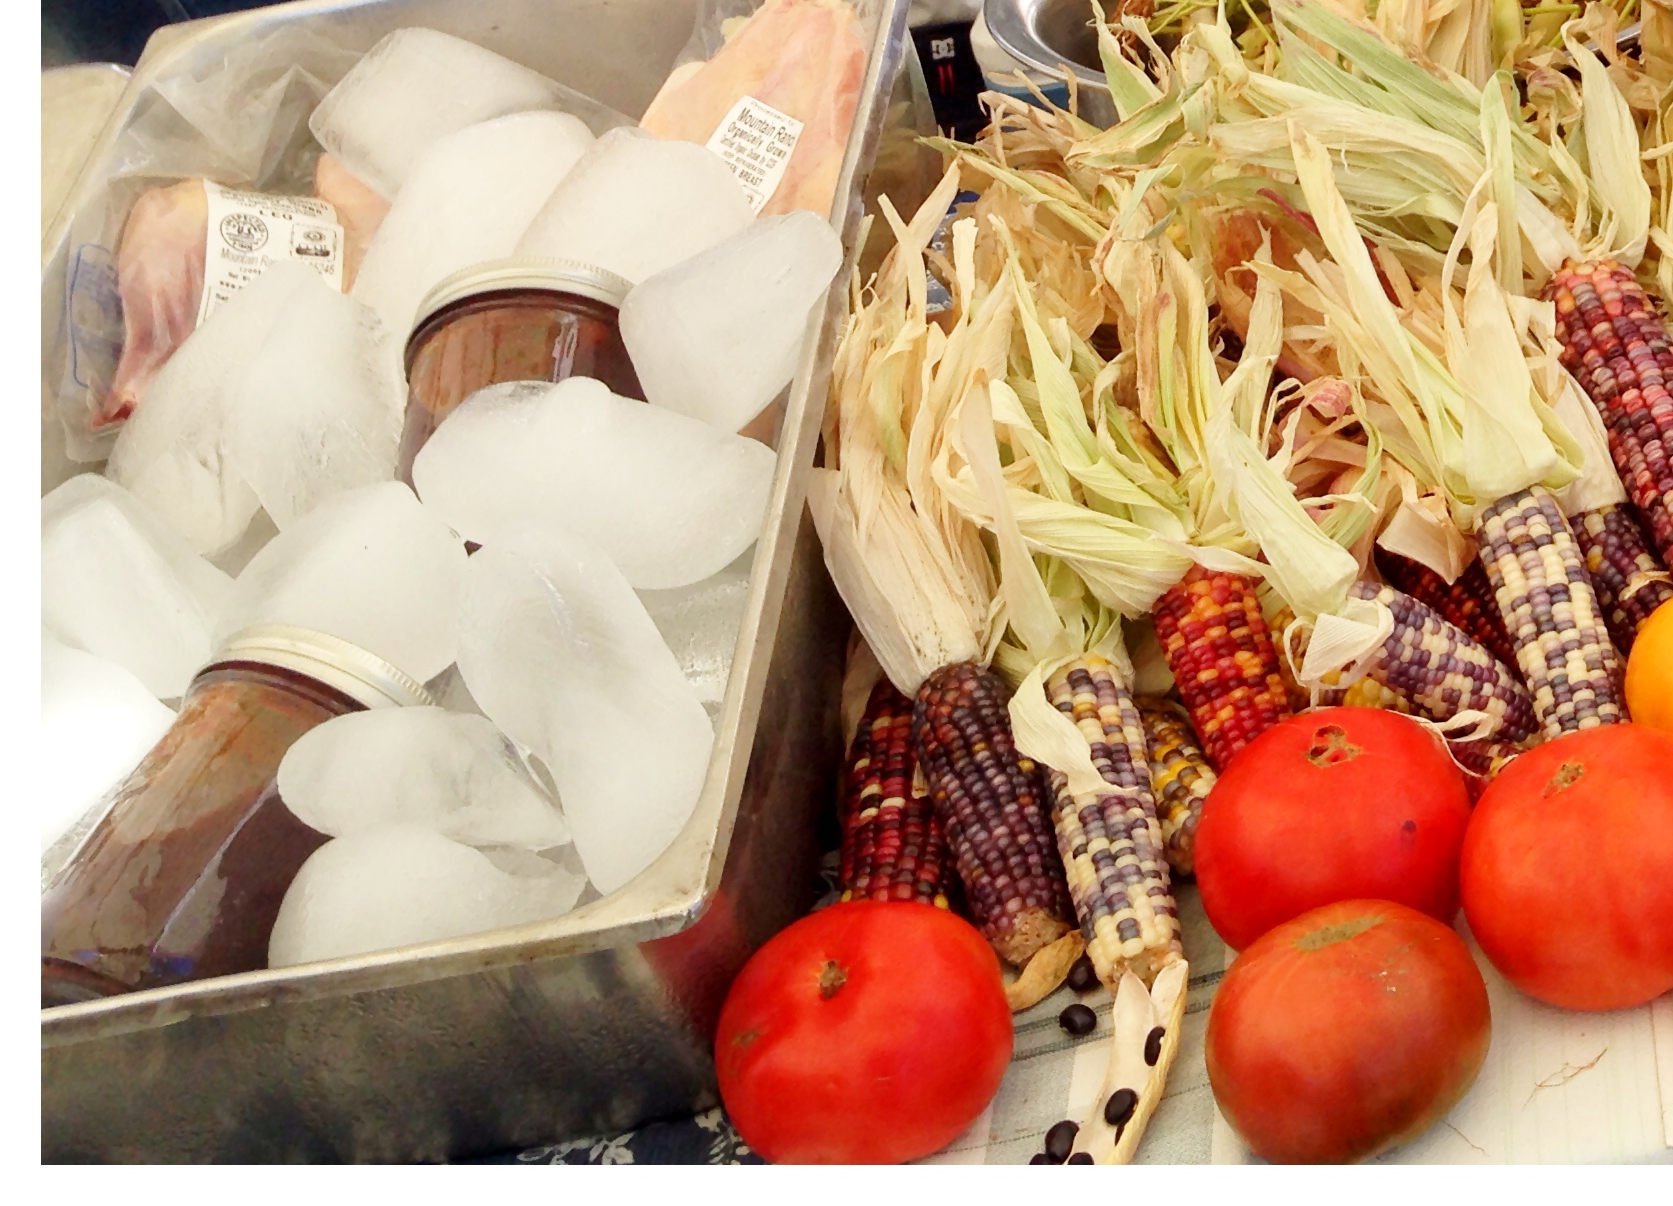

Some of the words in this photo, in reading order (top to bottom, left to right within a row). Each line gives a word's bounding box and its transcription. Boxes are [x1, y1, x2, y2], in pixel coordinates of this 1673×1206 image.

[737, 107, 776, 137] Mountain
[727, 121, 764, 149] Organically
[765, 140, 787, 160] Grown
[738, 169, 763, 187] BREAST
